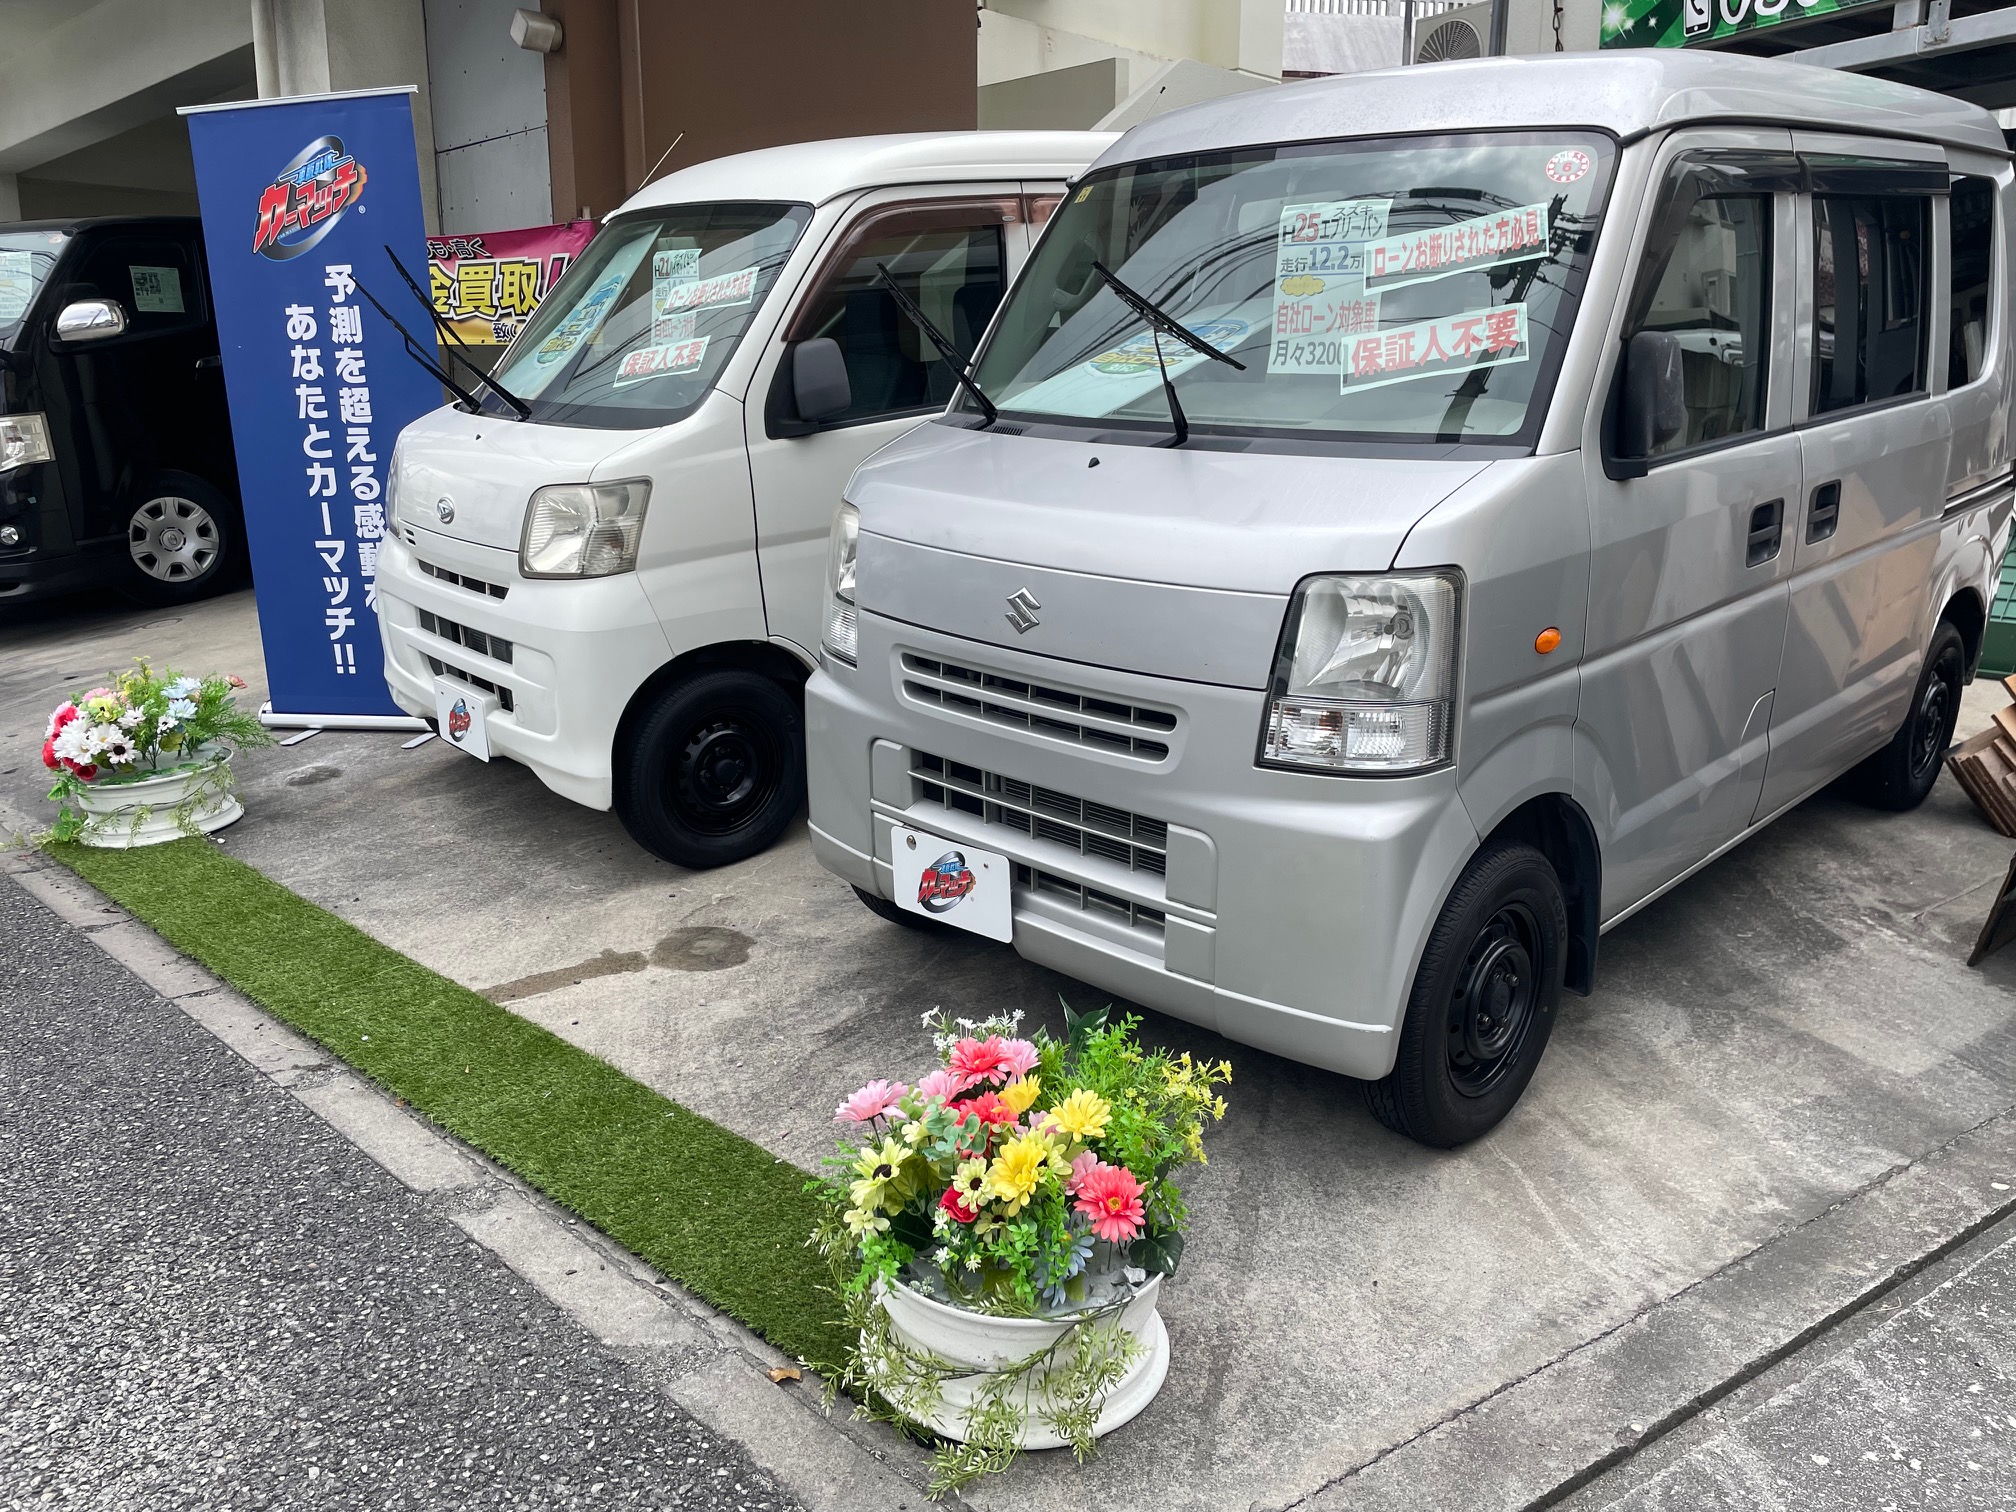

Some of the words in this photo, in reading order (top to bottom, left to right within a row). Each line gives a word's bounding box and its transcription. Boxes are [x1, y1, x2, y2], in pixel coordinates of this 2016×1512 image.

[252, 161, 358, 253] カーマッチ
[1333, 205, 1374, 218] スズキ
[1282, 213, 1321, 243] H25
[1374, 210, 1540, 277] ローンお断りされた方必見
[427, 237, 491, 259] も・高く
[1280, 245, 1364, 273] 走行12.2万
[655, 257, 670, 278] H21
[1277, 300, 1376, 334] 自社ローン対象車
[623, 341, 704, 377] 保証人不要
[1352, 309, 1518, 378] 保証人不要
[284, 303, 356, 674] あなたとカーマッチ!!
[917, 868, 971, 903] カーマッチ
